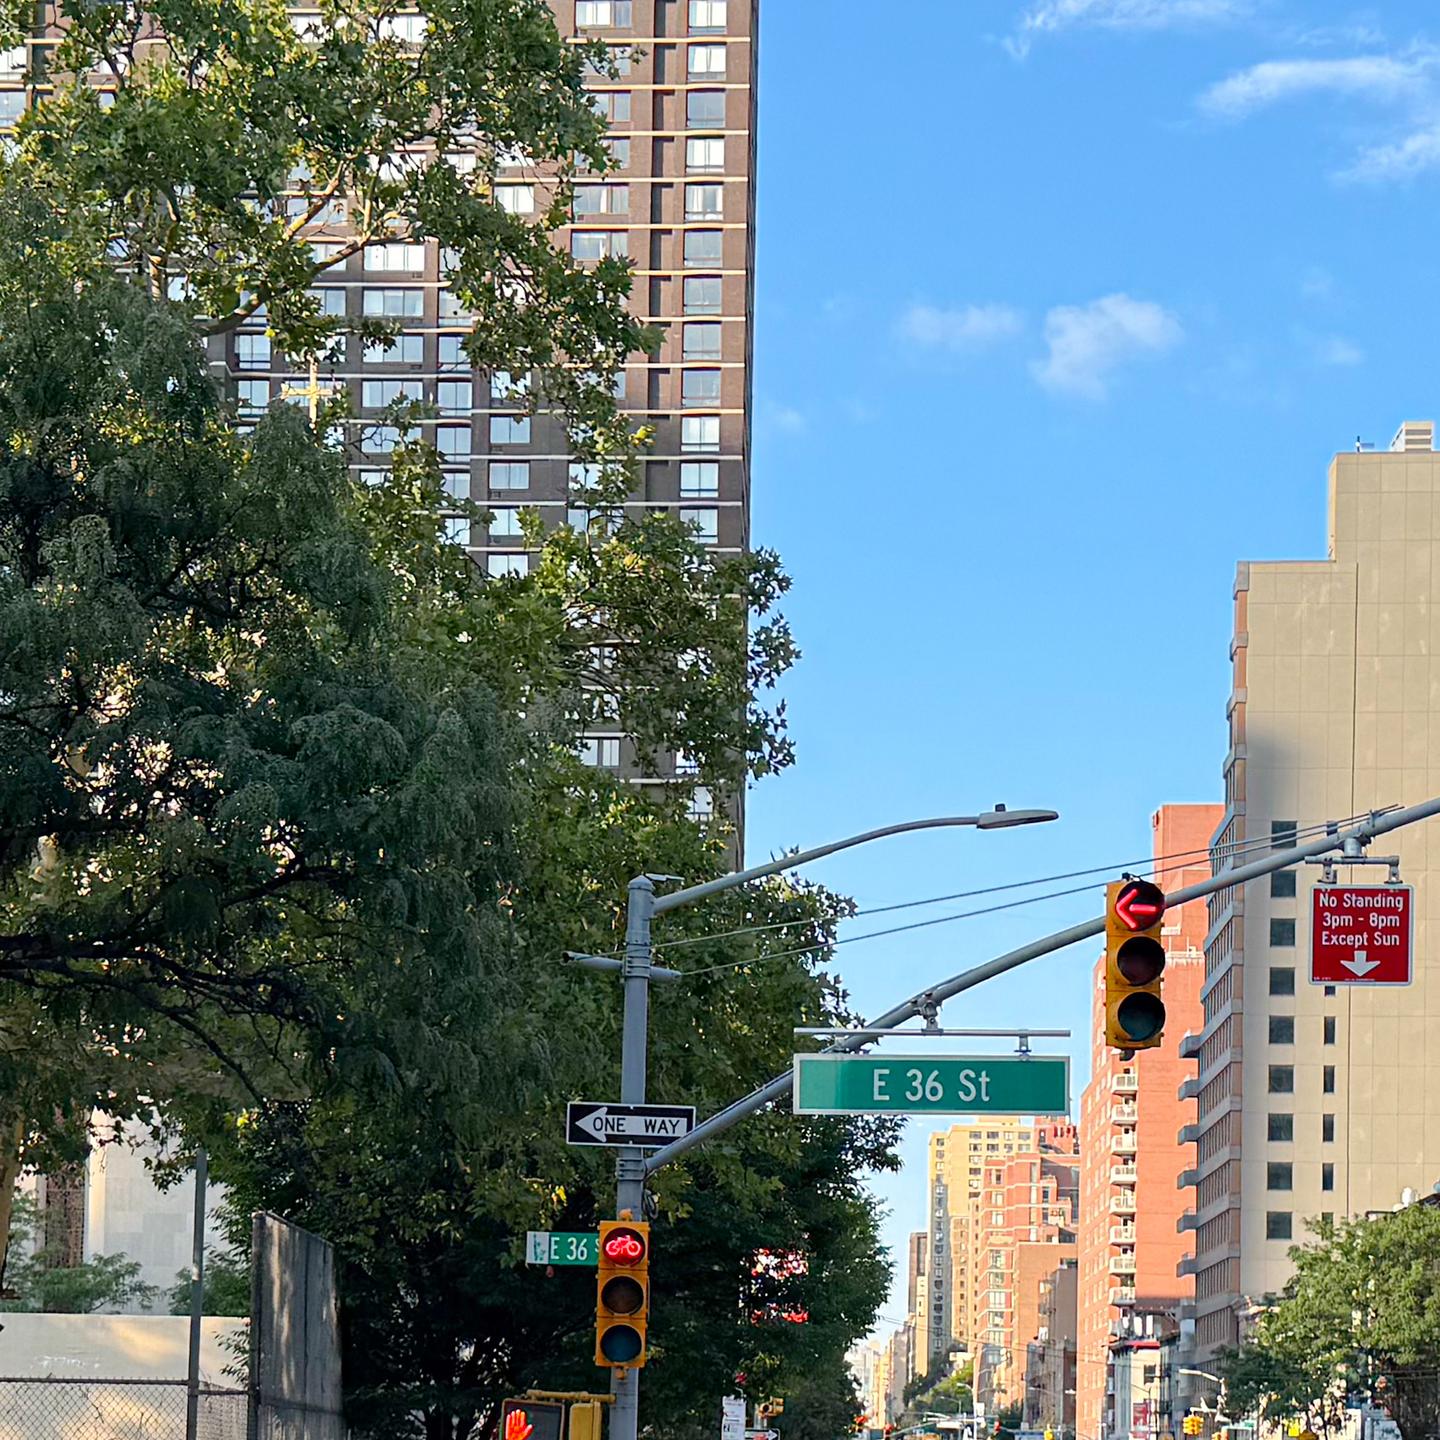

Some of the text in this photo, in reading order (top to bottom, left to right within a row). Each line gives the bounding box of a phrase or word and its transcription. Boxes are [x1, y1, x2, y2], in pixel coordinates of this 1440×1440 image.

[1319, 892, 1404, 912] No Standing
[1322, 911, 1353, 929] 3pm
[1369, 912, 1400, 930] 8pm
[1321, 931, 1400, 949] Except Sun
[873, 1068, 991, 1102] E 36 St
[592, 1116, 680, 1134] ONE WAY
[550, 1237, 560, 1260] E
[566, 1236, 588, 1261] 36
